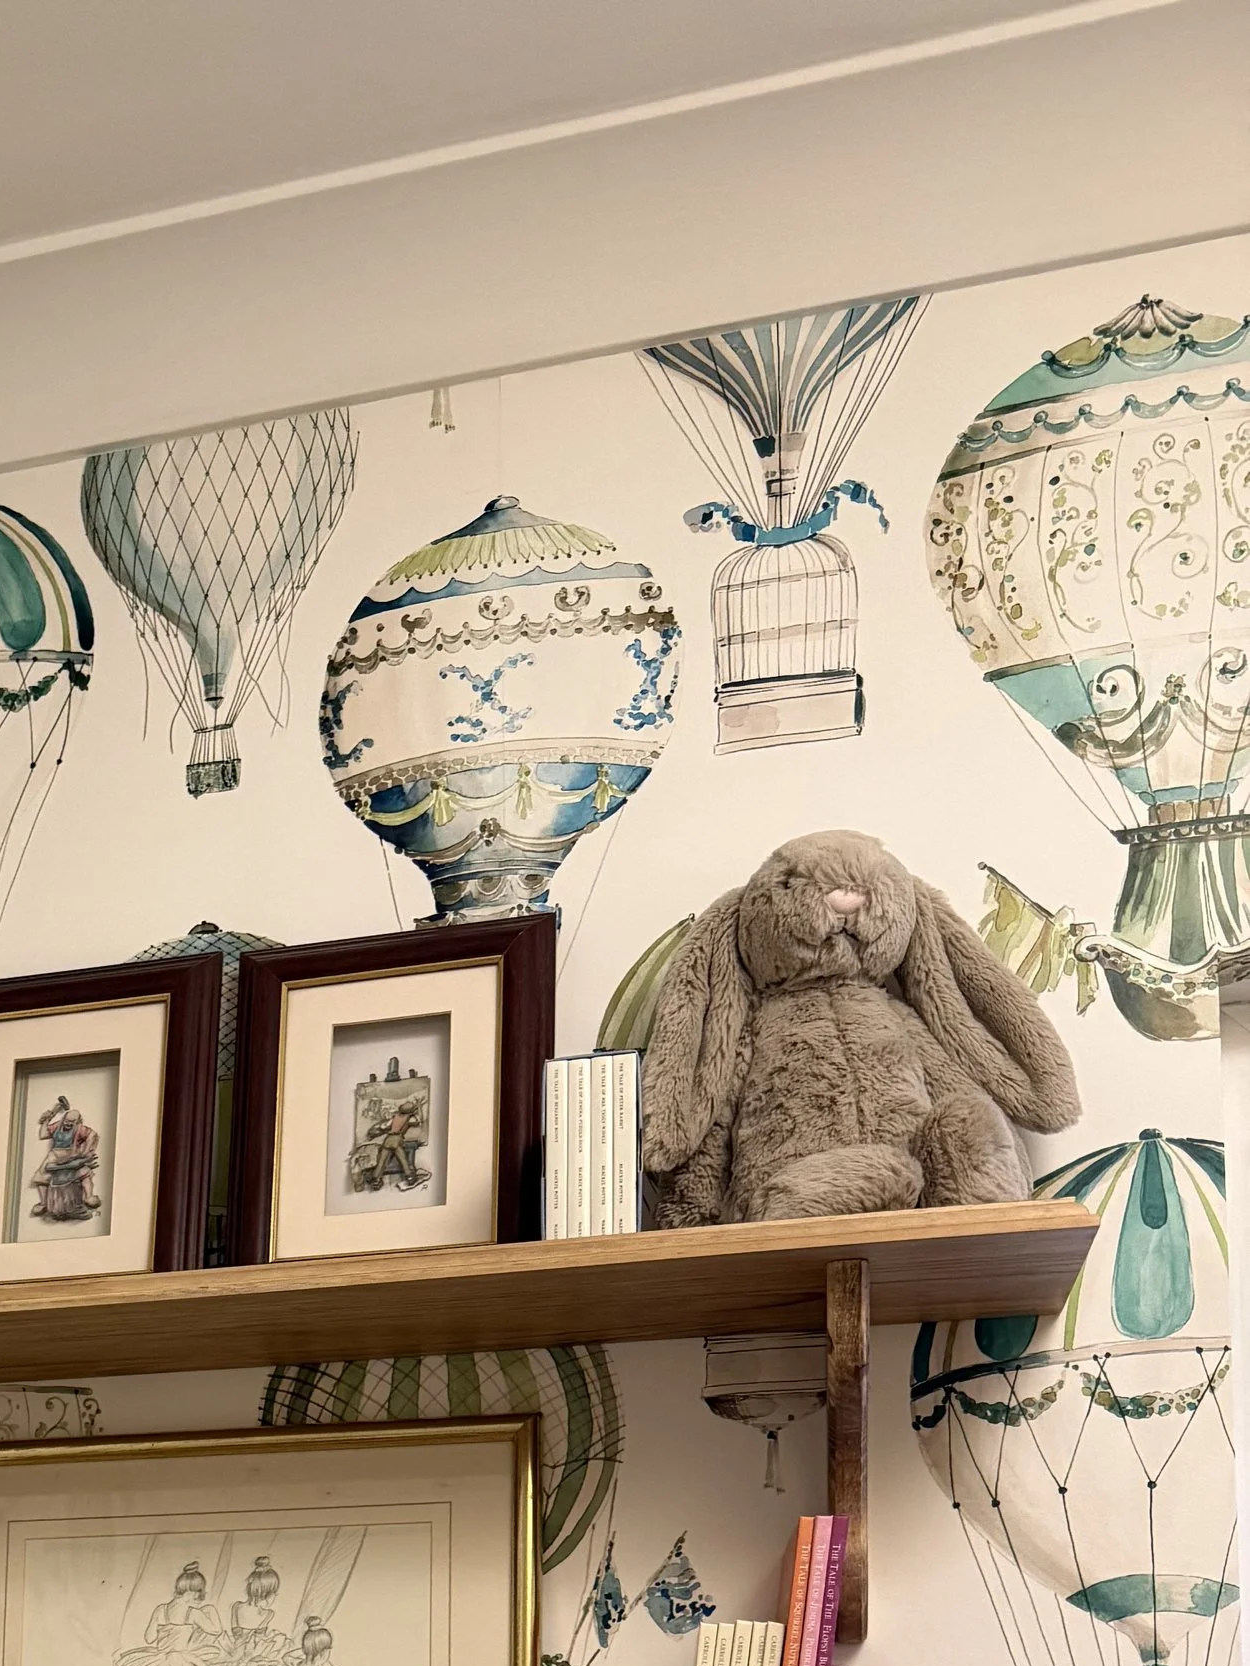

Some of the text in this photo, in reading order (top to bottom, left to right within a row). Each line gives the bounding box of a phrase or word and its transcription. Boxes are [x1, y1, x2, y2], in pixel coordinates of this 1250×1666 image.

[800, 1544, 811, 1562] THE
[816, 1543, 827, 1559] THE
[831, 1543, 842, 1561] THE
[797, 1564, 809, 1586] TALE
[812, 1563, 824, 1585] TALE
[827, 1563, 839, 1586] TALE
[827, 1588, 835, 1600] OF
[790, 1602, 803, 1639] SQUIRREL
[805, 1600, 820, 1633] JEMIMA
[824, 1603, 835, 1620] THE
[820, 1625, 832, 1654] FLOPSY
